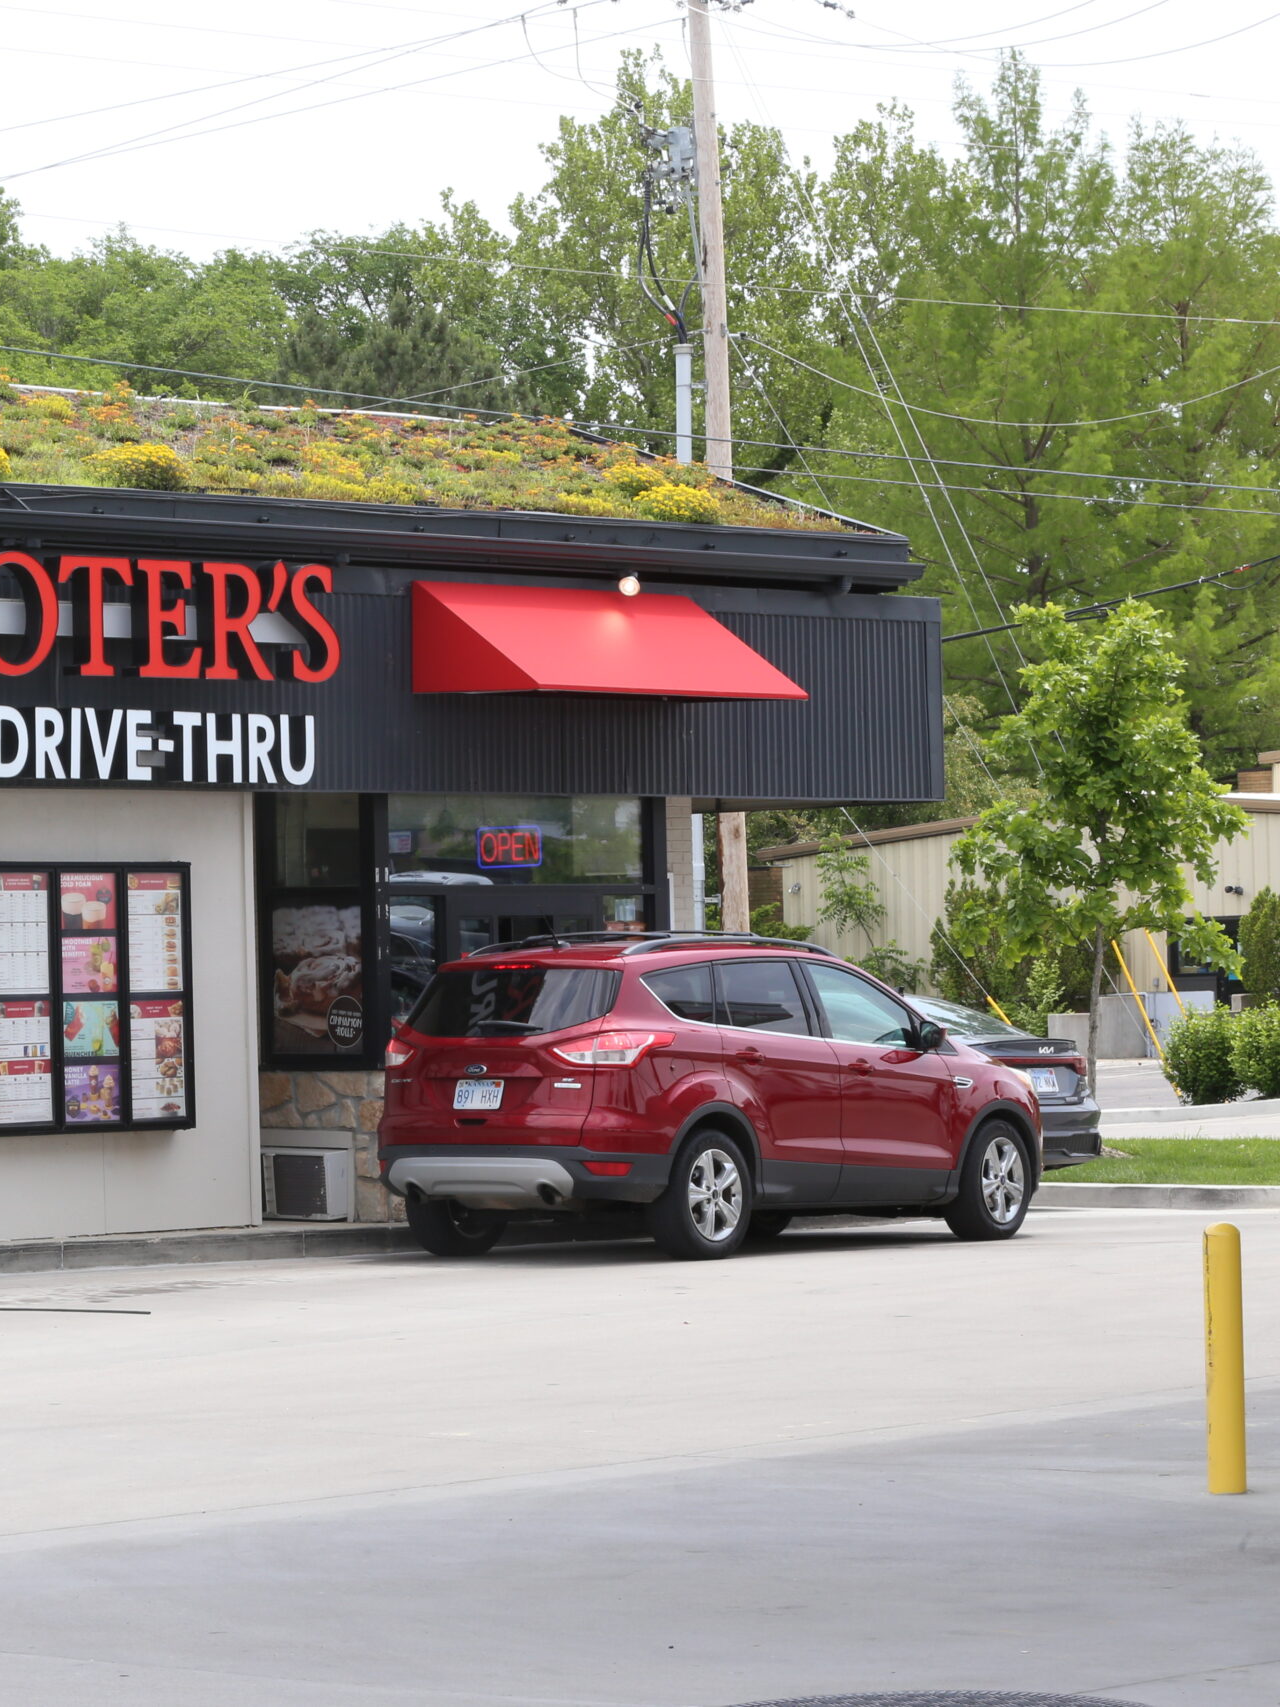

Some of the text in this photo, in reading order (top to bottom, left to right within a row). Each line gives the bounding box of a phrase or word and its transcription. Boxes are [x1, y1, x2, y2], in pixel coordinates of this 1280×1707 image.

[480, 831, 539, 863] OPEN
[329, 1015, 363, 1029] CINNAMON
[456, 1089, 500, 1105] 891 HXH
